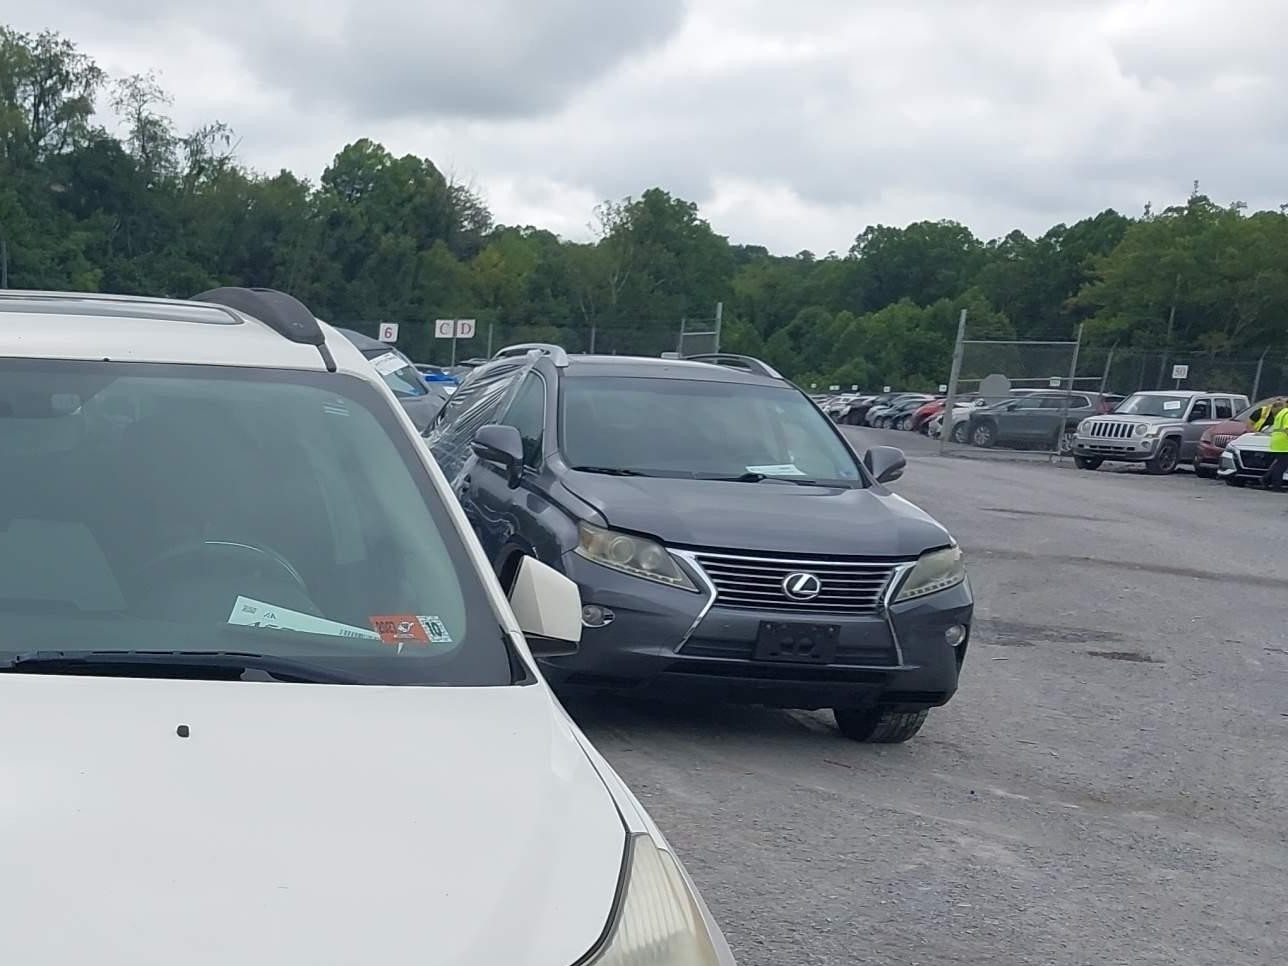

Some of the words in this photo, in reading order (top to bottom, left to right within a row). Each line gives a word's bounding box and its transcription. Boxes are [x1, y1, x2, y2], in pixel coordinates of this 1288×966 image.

[384, 327, 392, 339] 6
[439, 323, 450, 335] C
[460, 323, 472, 335] D
[424, 621, 443, 637] 10
